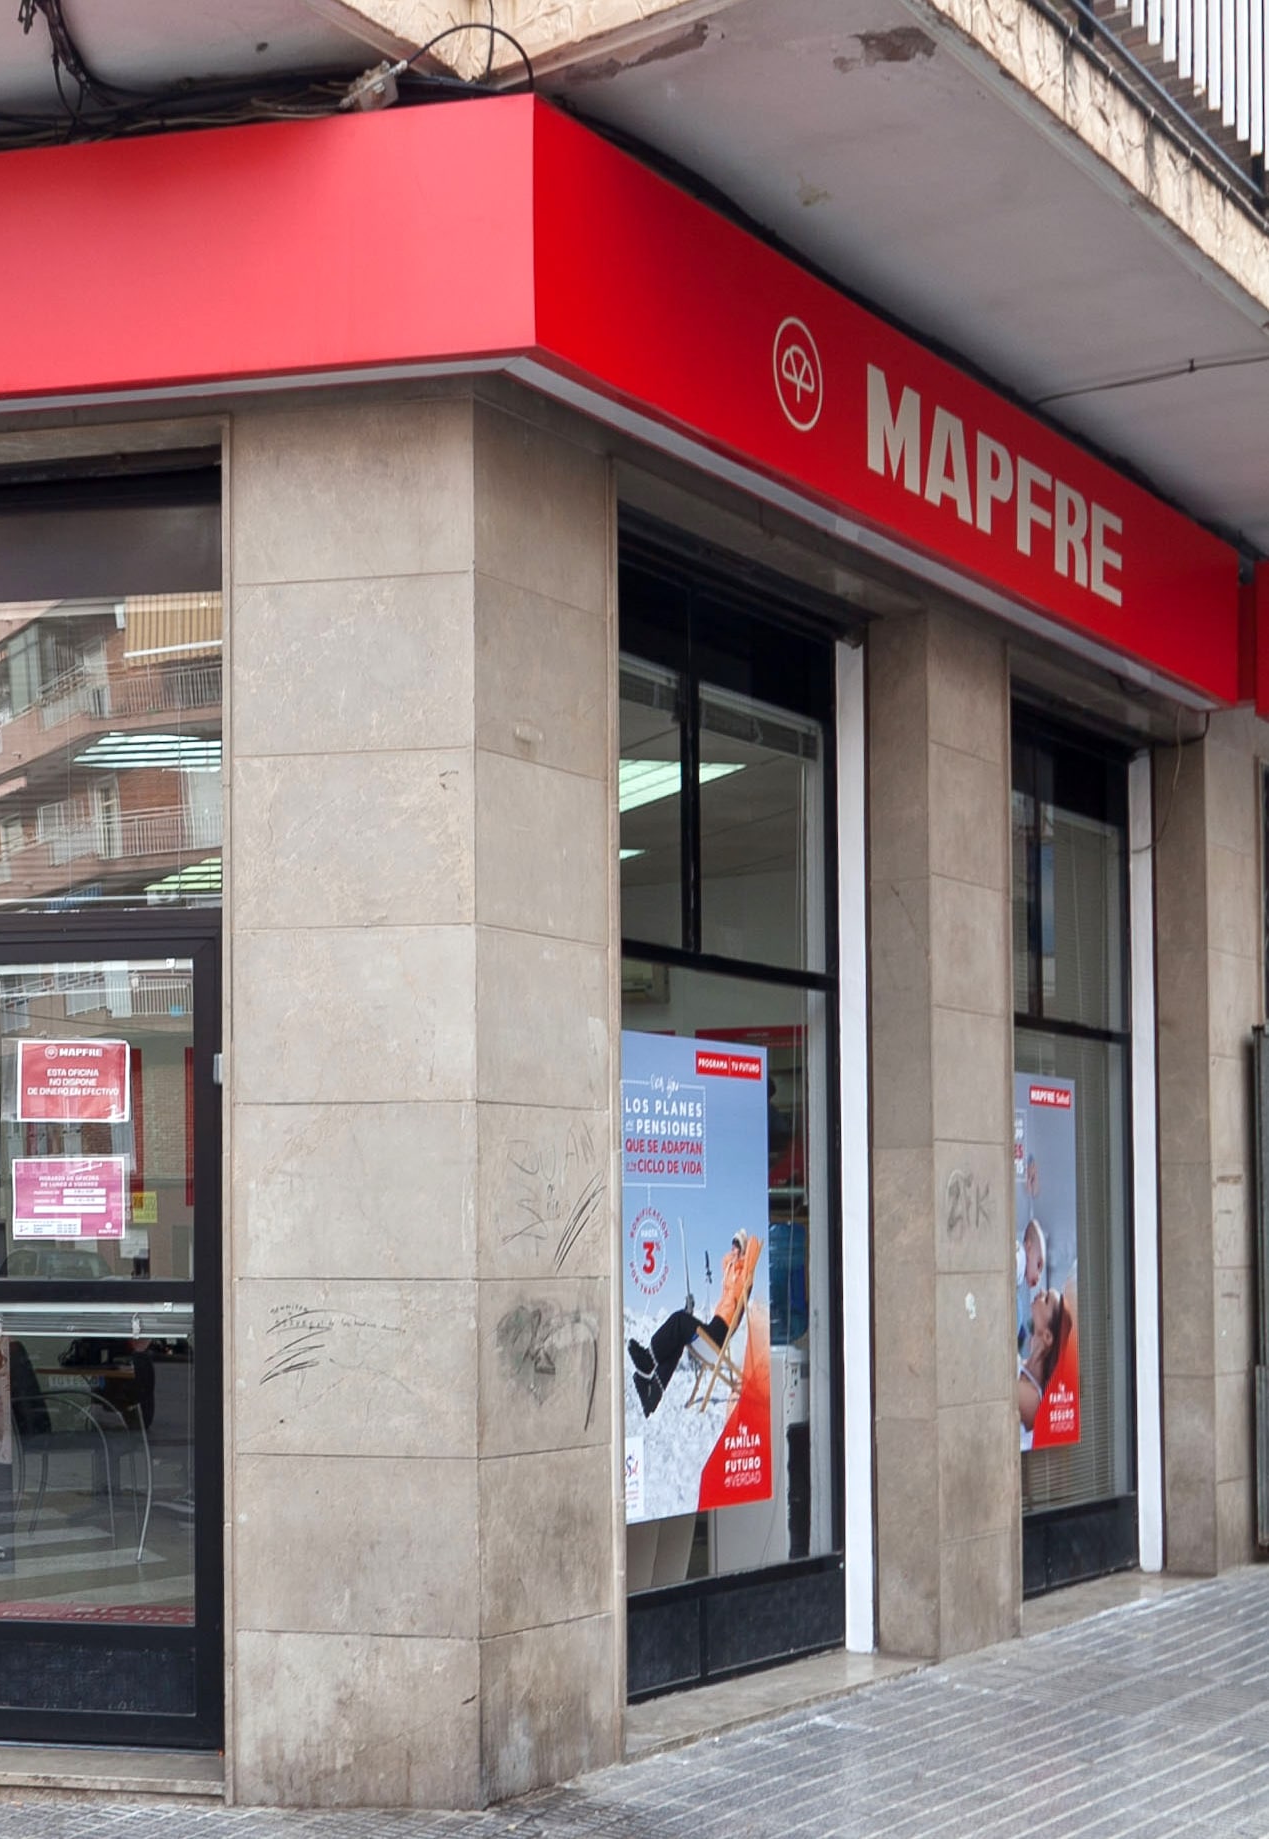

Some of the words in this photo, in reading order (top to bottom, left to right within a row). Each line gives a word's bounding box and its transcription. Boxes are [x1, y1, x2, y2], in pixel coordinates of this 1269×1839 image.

[867, 362, 1123, 607] MAPFRE
[59, 1047, 103, 1058] MAPFRE
[46, 1068, 67, 1077] ESTA
[67, 1068, 99, 1077] OFICINA
[49, 1078, 62, 1086] NO
[62, 1077, 97, 1087] DISPONE
[27, 1087, 38, 1096] DE
[39, 1087, 68, 1096] DINERO
[69, 1087, 81, 1096] EN
[82, 1087, 119, 1096] EFECTIVO
[625, 1097, 649, 1114] LOS
[655, 1099, 703, 1117] PLANES
[636, 1118, 703, 1138] PENSIONES
[625, 1137, 644, 1154] QUE
[647, 1138, 659, 1154] SE
[661, 1140, 703, 1155] ADAPTAN
[637, 1158, 665, 1174] CICLO
[667, 1159, 679, 1174] DE
[681, 1160, 703, 1175] VIDA
[724, 1434, 761, 1451] FAMILIA
[725, 1456, 761, 1473] FUTURO
